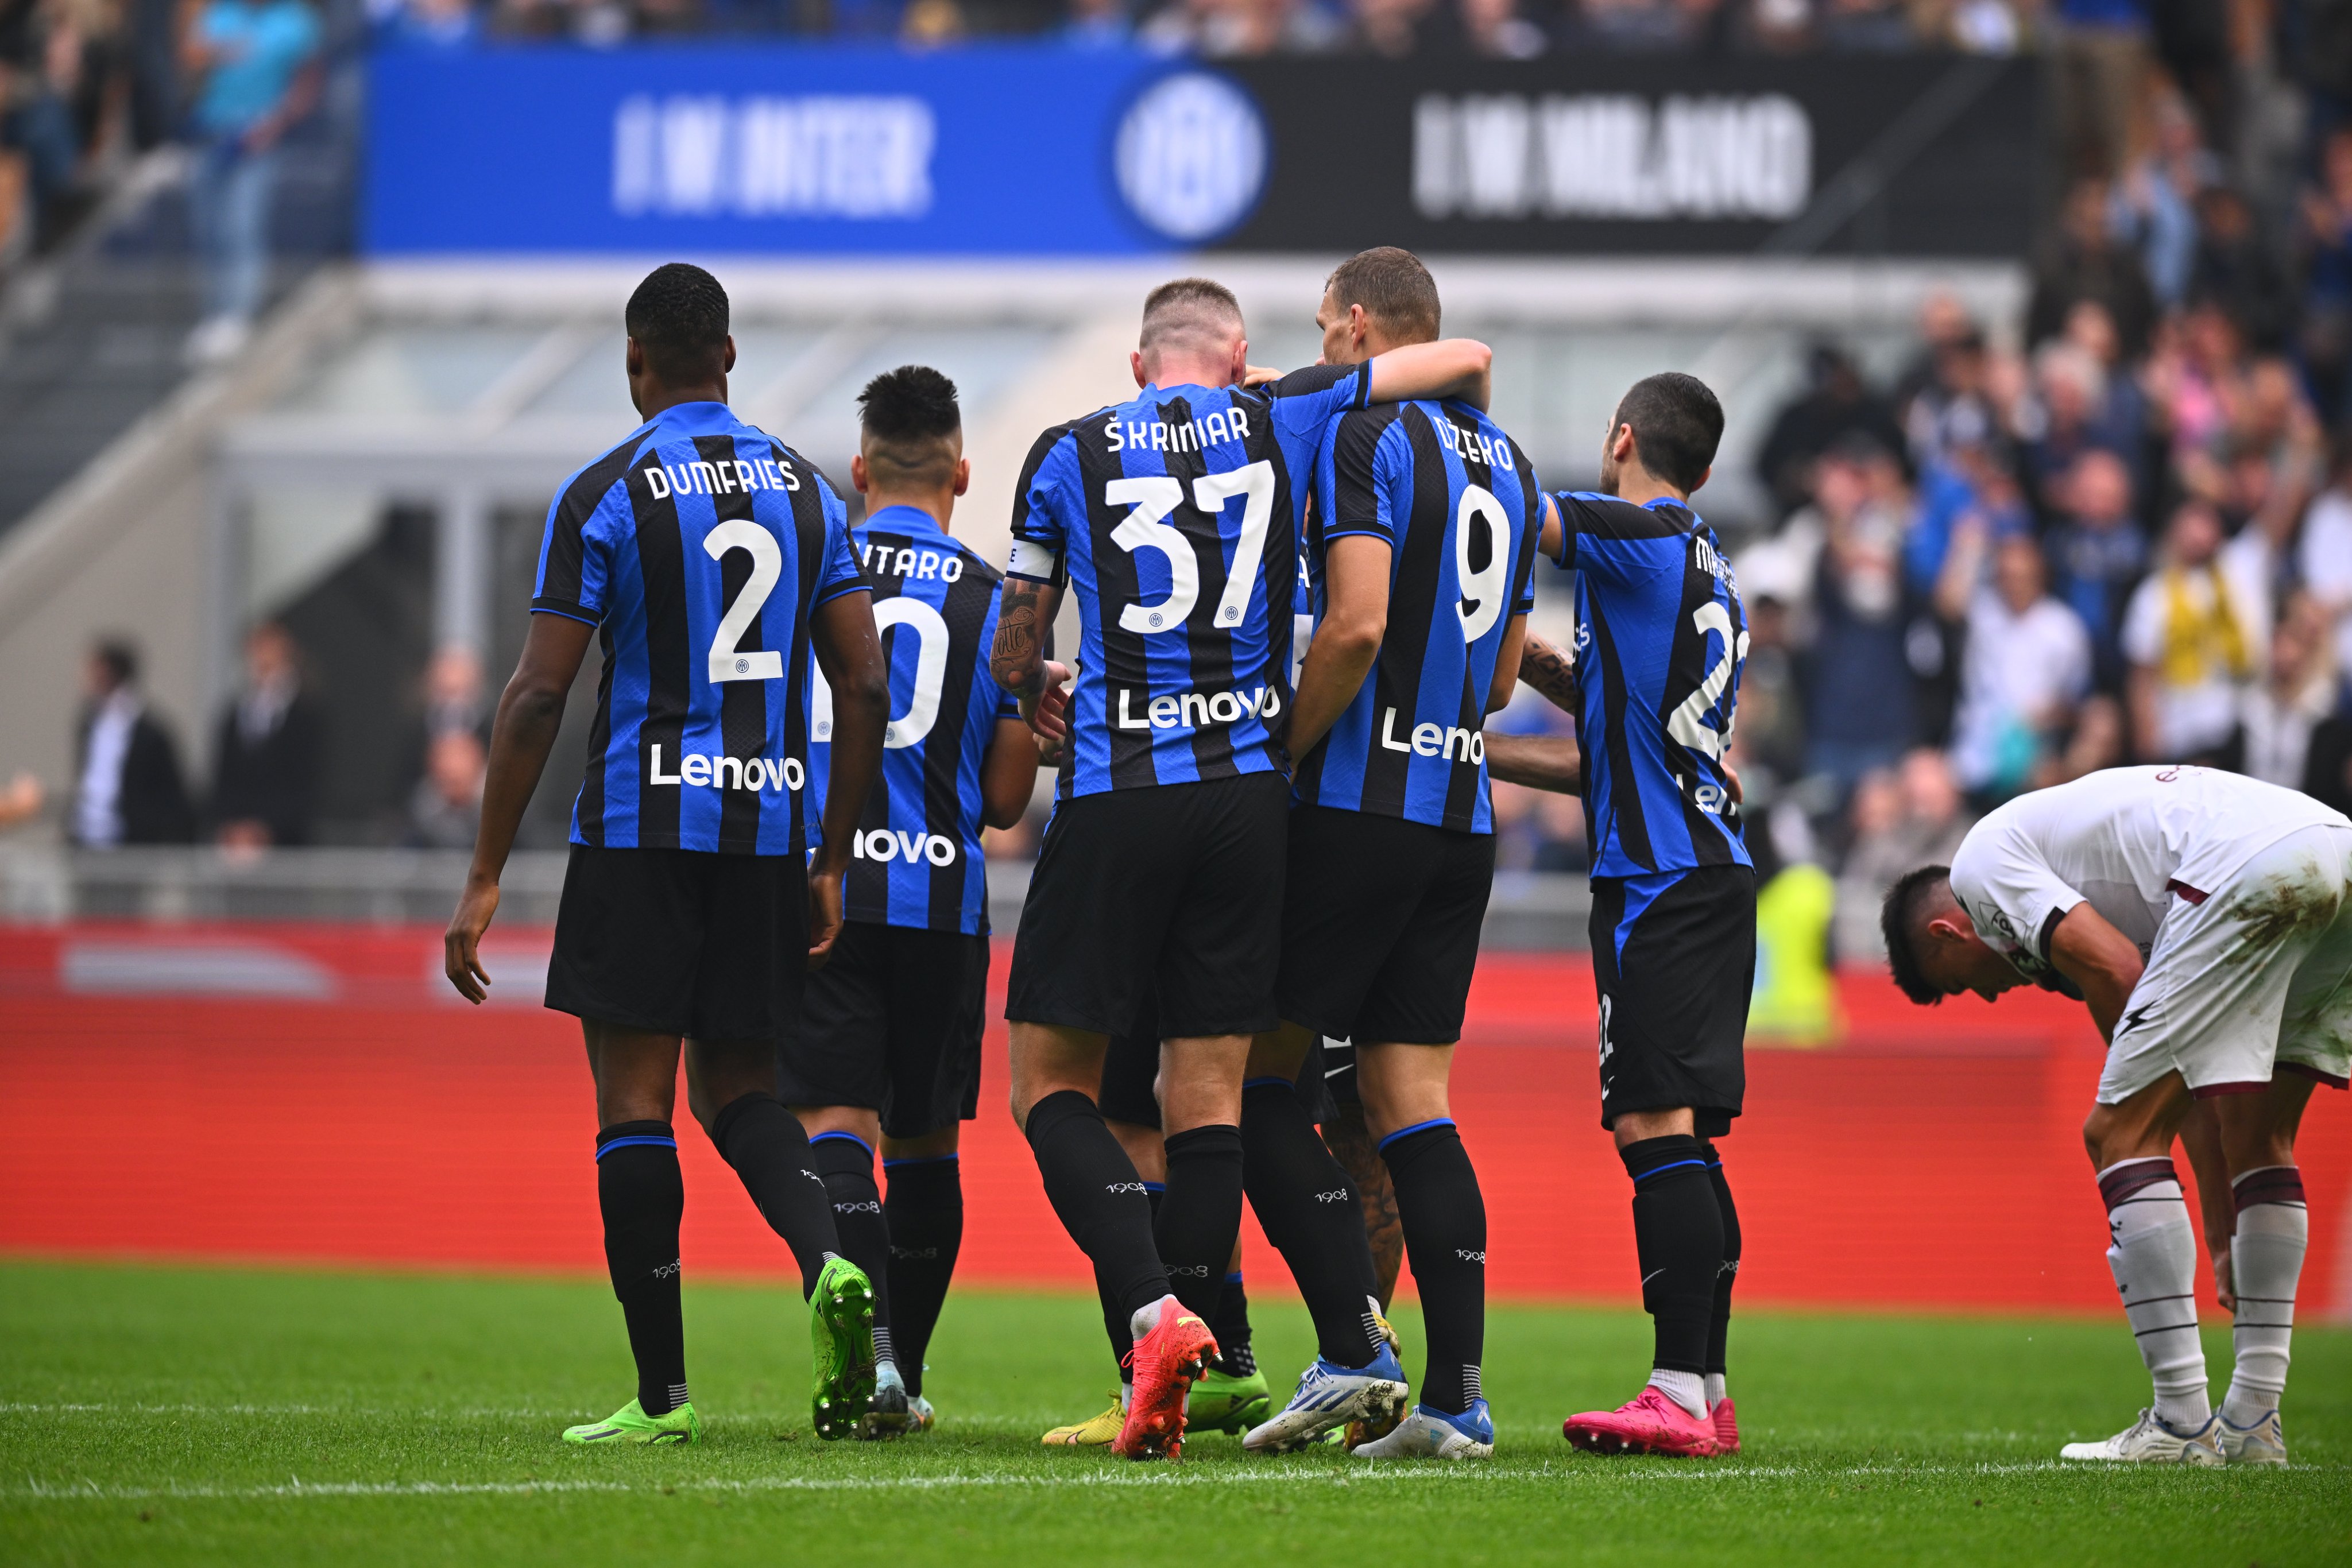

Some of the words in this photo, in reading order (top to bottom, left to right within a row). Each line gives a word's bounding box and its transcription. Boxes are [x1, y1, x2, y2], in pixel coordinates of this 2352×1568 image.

[1104, 408, 1251, 452] ŠKRINIAR
[644, 459, 800, 500] DUMFRIES
[1105, 460, 1276, 633] 37
[1454, 483, 1511, 643] 9
[702, 518, 783, 684] 2
[1119, 685, 1281, 729] Lenovo
[1382, 706, 1485, 765] Leno
[649, 744, 804, 792] Lenovo
[833, 1201, 880, 1214] 1908
[1105, 1182, 1148, 1195] 1908
[1314, 1188, 1348, 1203] 1908
[652, 1258, 682, 1279] 1908
[1163, 1263, 1209, 1278] 908
[1454, 1249, 1486, 1264] 1908
